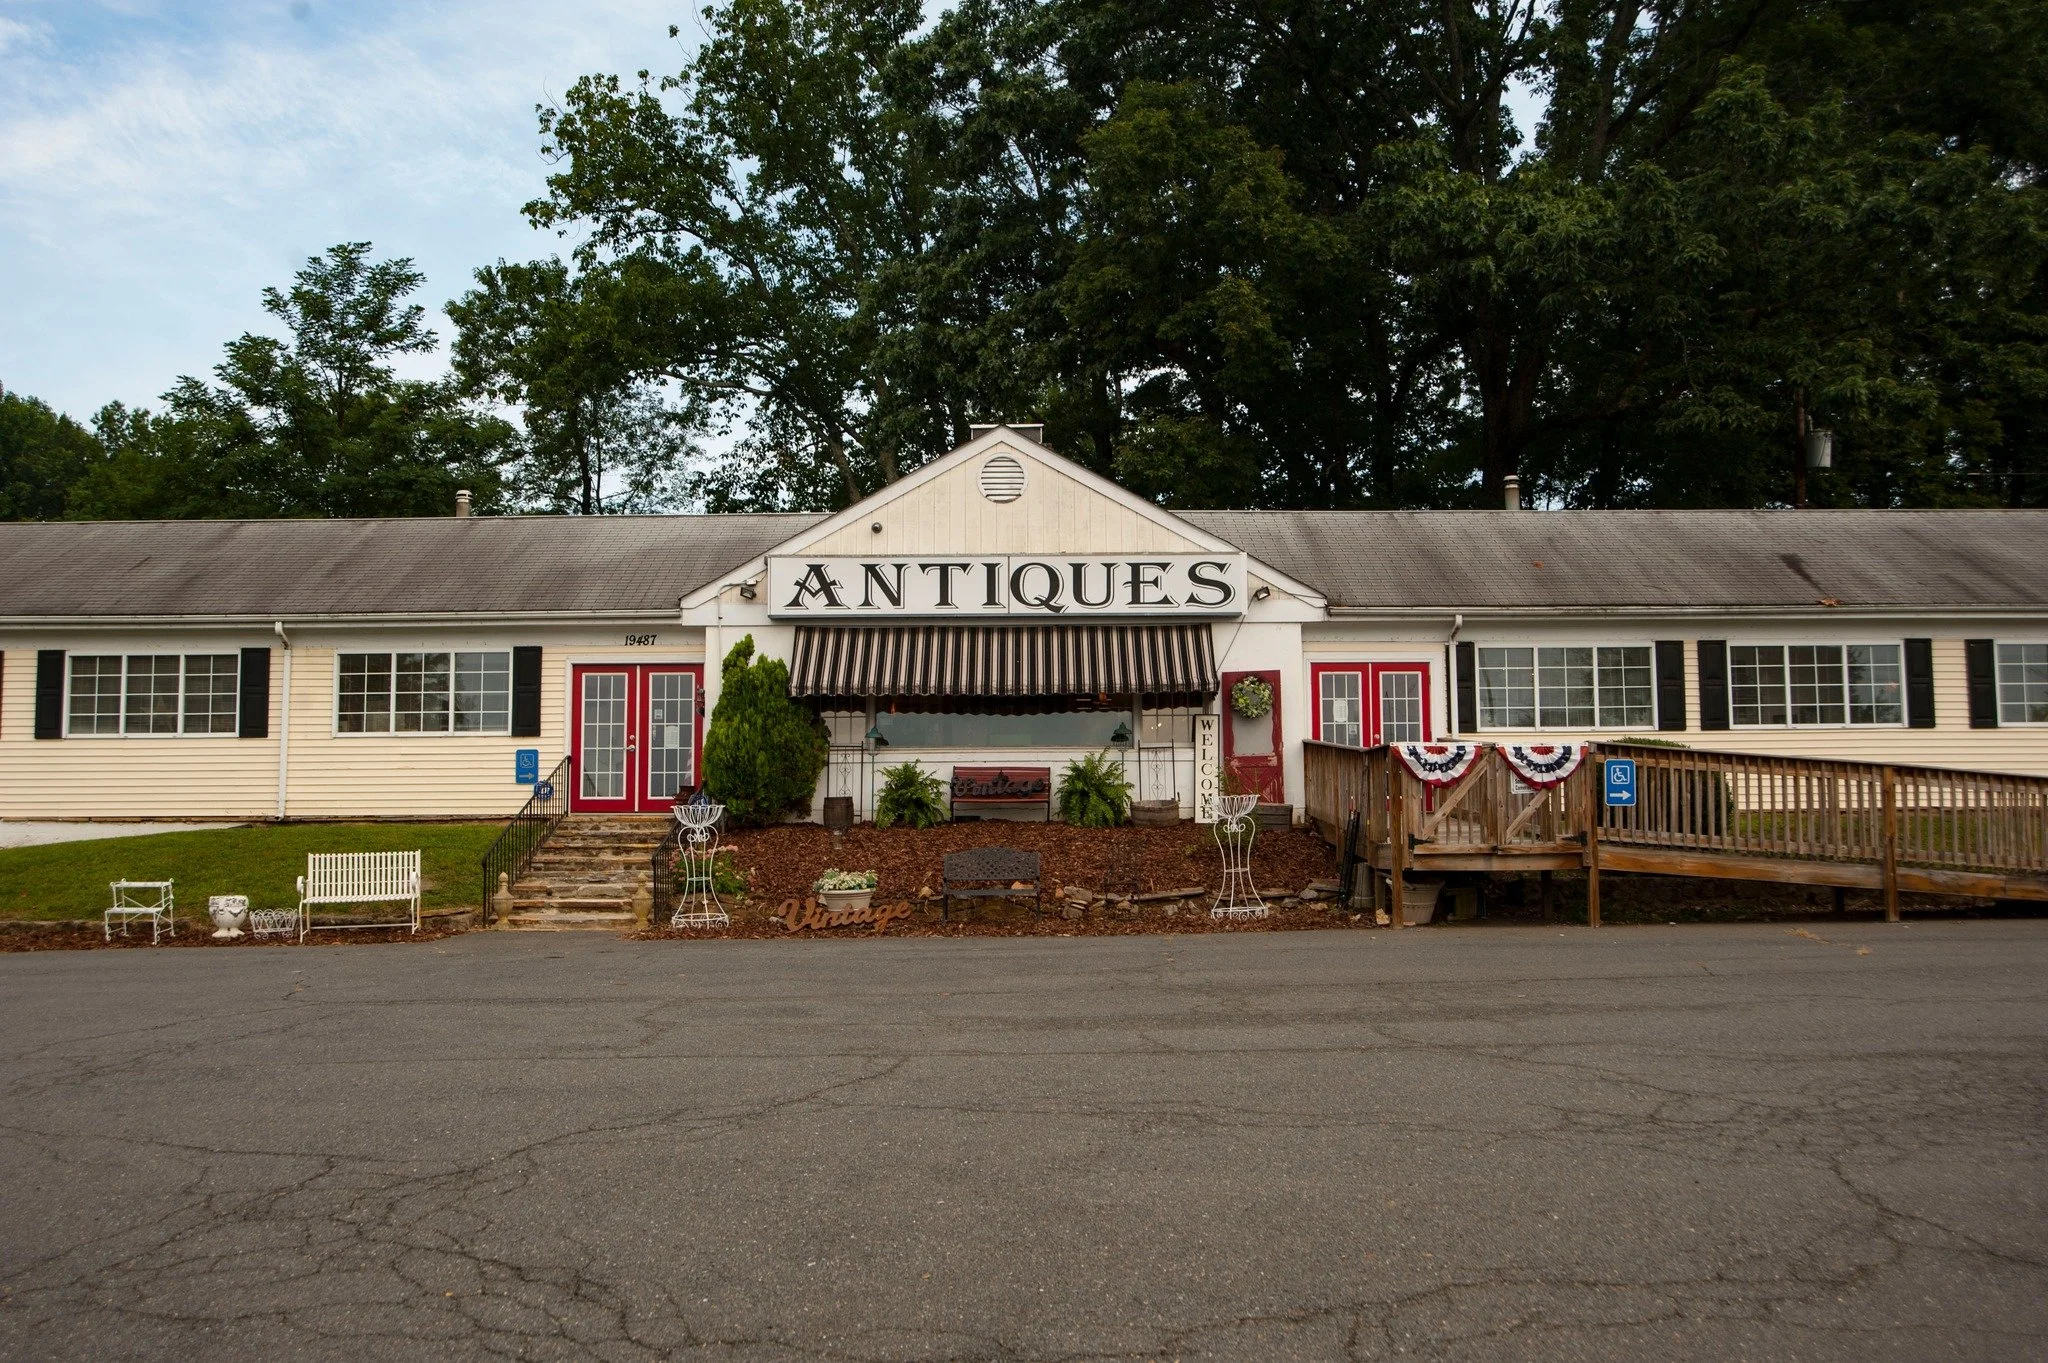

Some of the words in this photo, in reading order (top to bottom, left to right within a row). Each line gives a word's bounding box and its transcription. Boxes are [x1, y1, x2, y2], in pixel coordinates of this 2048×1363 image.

[784, 561, 1236, 614] ANTIQUES
[624, 634, 657, 646] 19487
[1201, 719, 1214, 820] WELCOME
[778, 896, 912, 934] Vintage
